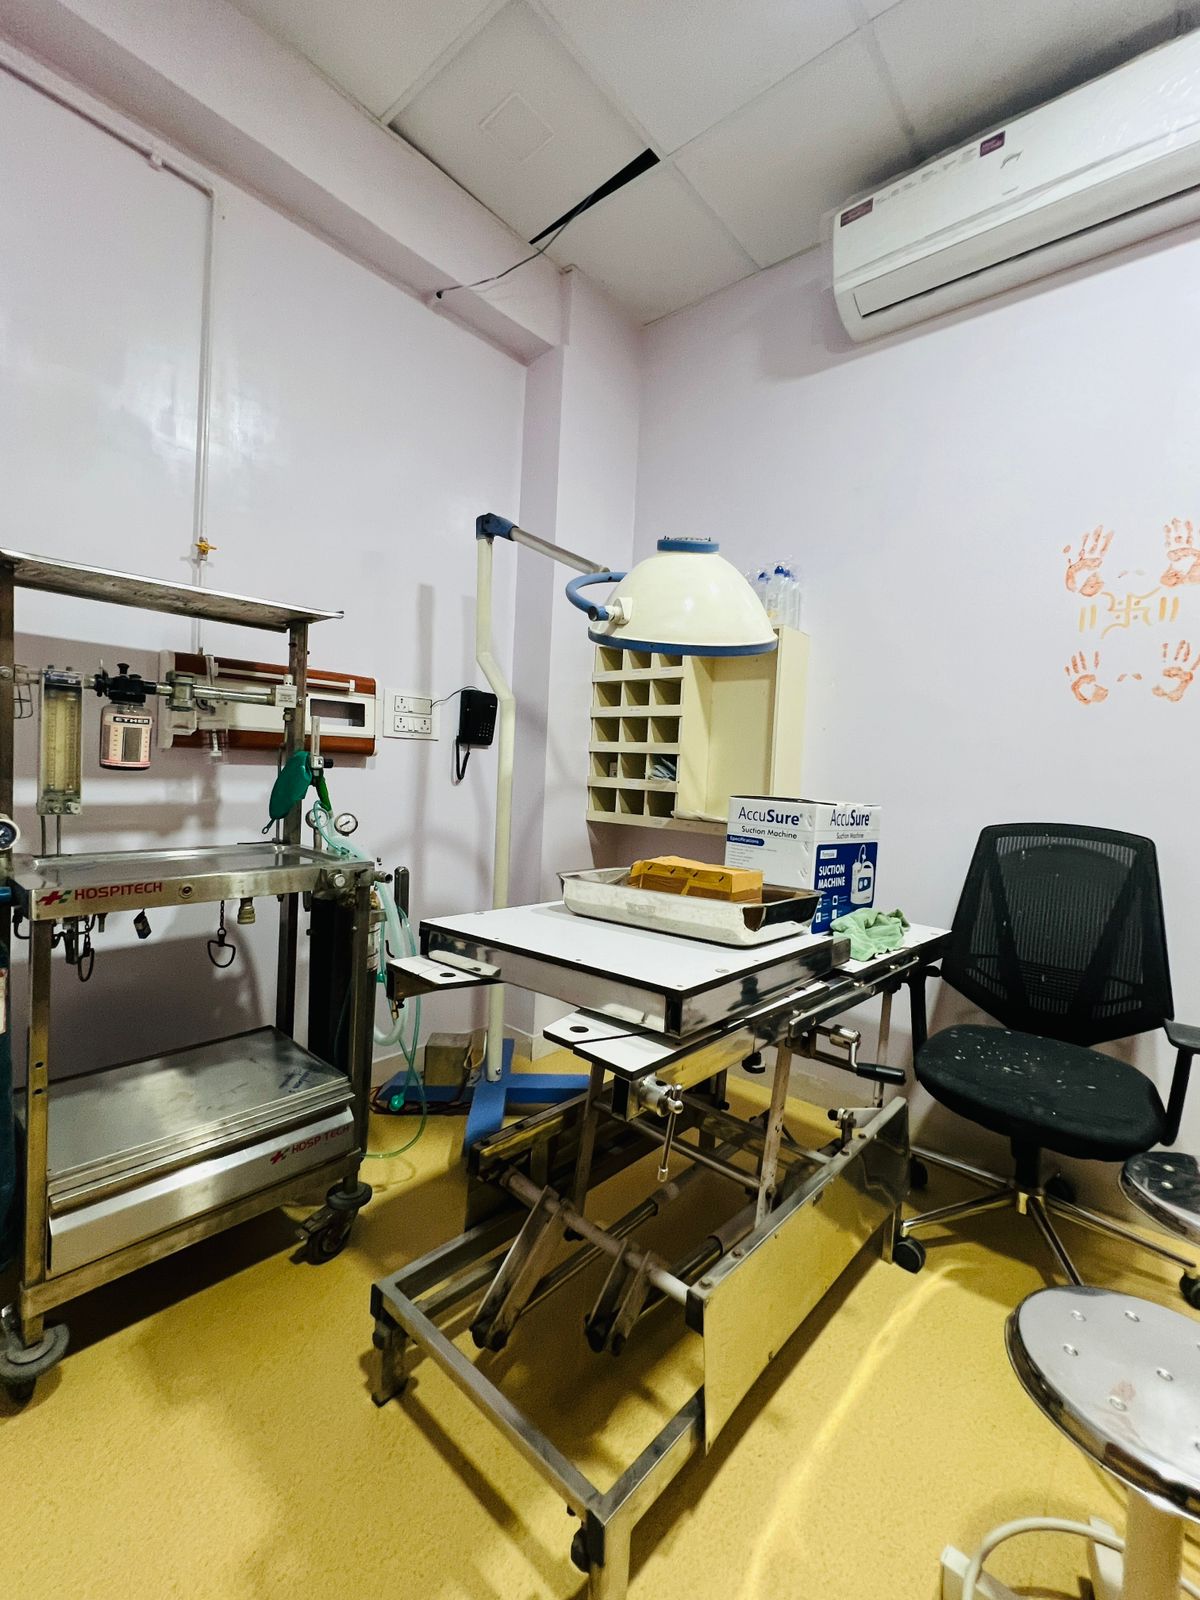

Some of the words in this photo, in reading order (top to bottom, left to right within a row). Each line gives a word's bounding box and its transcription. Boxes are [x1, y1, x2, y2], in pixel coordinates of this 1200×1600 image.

[738, 806, 800, 826] AccuSure
[830, 809, 870, 827] AccuSure
[741, 825, 766, 836] Suction
[767, 827, 798, 840] Machine
[818, 864, 845, 876] SUCTION
[74, 881, 163, 901] HOSPITECH
[817, 876, 846, 890] MACHINE
[292, 1125, 350, 1154] HOSPTECH
